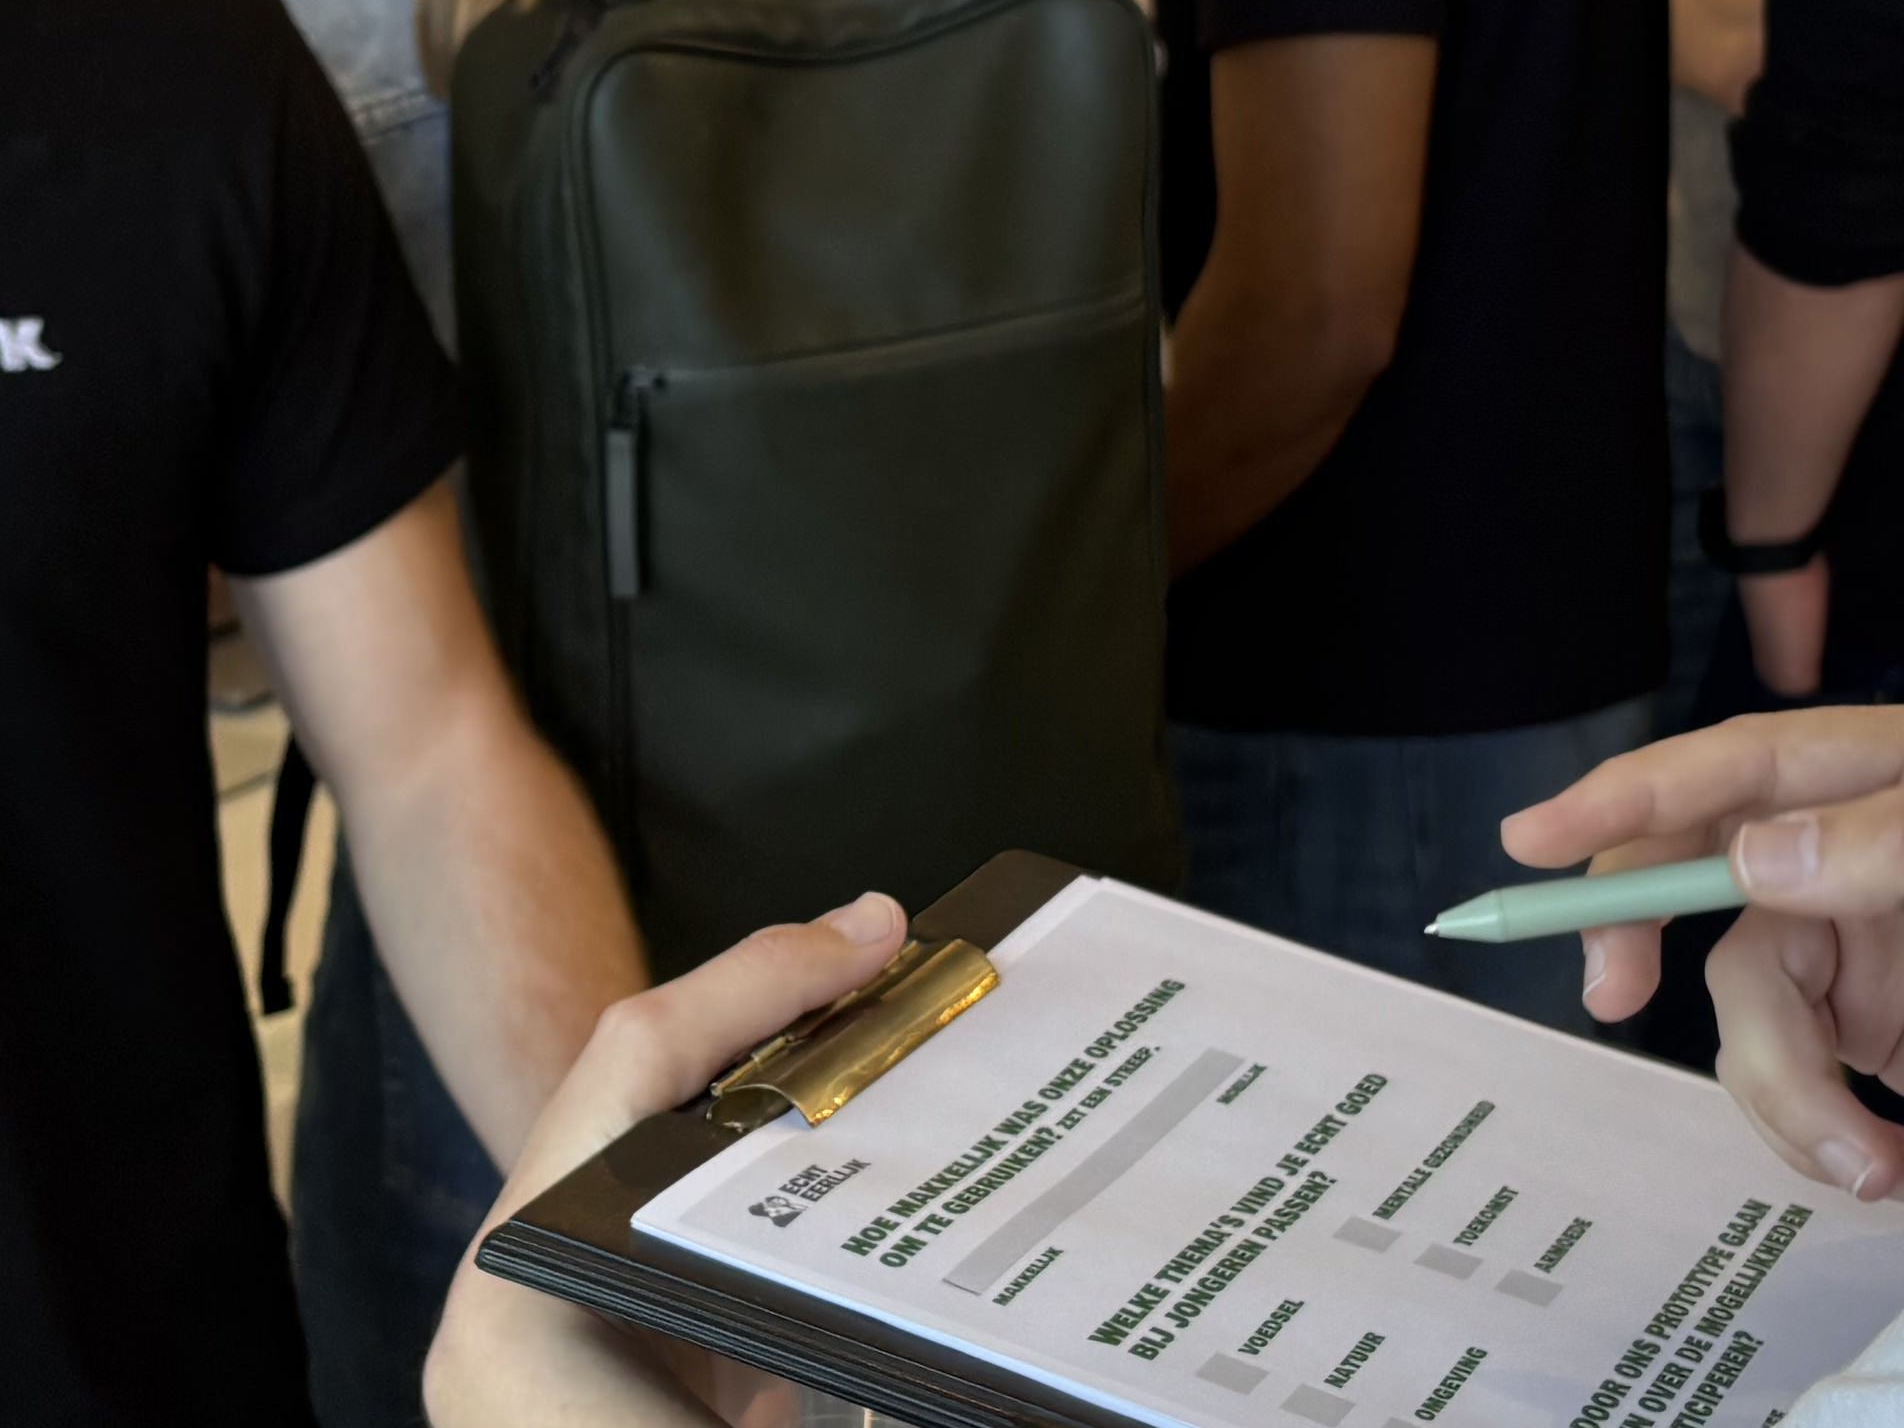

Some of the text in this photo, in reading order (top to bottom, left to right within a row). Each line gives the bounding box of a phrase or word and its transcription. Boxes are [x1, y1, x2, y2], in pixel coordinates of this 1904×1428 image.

[841, 978, 1186, 1256] HOE MAKKELIJK WAS ONZE OPLOSSING
[777, 1164, 829, 1195] ECHT
[799, 1158, 872, 1202] EERLIJK
[879, 1045, 1162, 1268] OM TE GEBRUIKEN? ZET EEN STREEP.
[1086, 1073, 1388, 1347] WELKE THEMA'S VIND JE ECHT GOED
[1372, 1167, 1433, 1221] MENTALE
[1452, 1184, 1519, 1247] TOEKOMST
[1127, 1170, 1339, 1361] BIJ JONGEREN PASSEN?
[1533, 1216, 1594, 1274] ARMOEDE
[1692, 1203, 1814, 1339] MOGELIJKHEDEN
[992, 1246, 1064, 1307] MAKKELIJK
[1613, 1338, 1662, 1381] ONS
[1643, 1244, 1736, 1341] PROTOTYPE
[1717, 1198, 1774, 1248] GAAN
[1237, 1297, 1306, 1357] VOEDSEL
[1674, 1335, 1714, 1364] DE
[1323, 1331, 1386, 1390] NATUUR
[1414, 1345, 1488, 1422] OMGEVING
[1638, 1362, 1695, 1414] OVER
